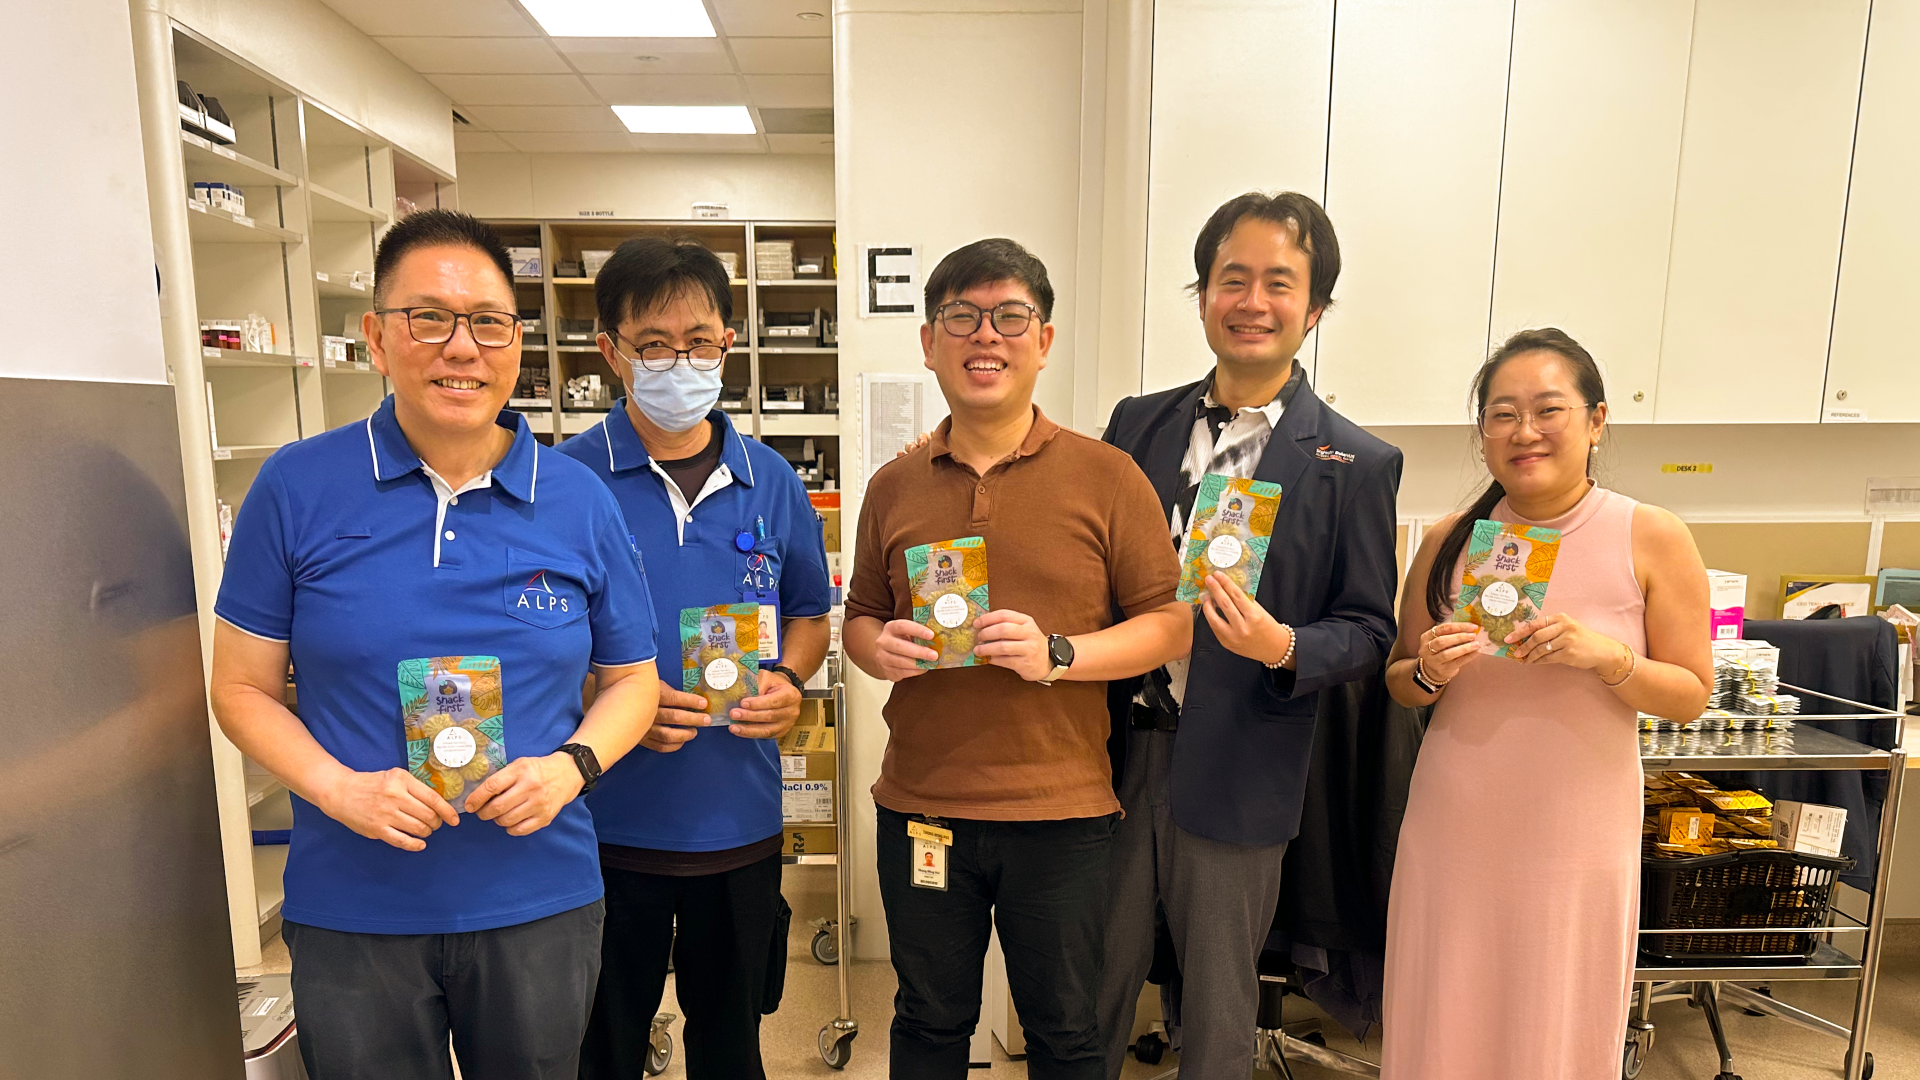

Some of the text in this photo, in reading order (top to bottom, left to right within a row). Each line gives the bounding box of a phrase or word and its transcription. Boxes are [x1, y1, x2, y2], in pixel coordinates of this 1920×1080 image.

[529, 262, 538, 270] 20
[867, 247, 915, 313] E
[1221, 509, 1245, 520] snack
[1220, 517, 1244, 526] first
[1495, 553, 1521, 565] snack
[934, 566, 958, 578] snack
[1494, 562, 1519, 572] first
[934, 575, 957, 586] first
[516, 592, 569, 613] ALPS
[707, 632, 731, 643] snack
[708, 640, 730, 650] first
[435, 693, 465, 706] snack
[436, 702, 465, 714] first
[782, 783, 828, 791] NaCl 0.9%
